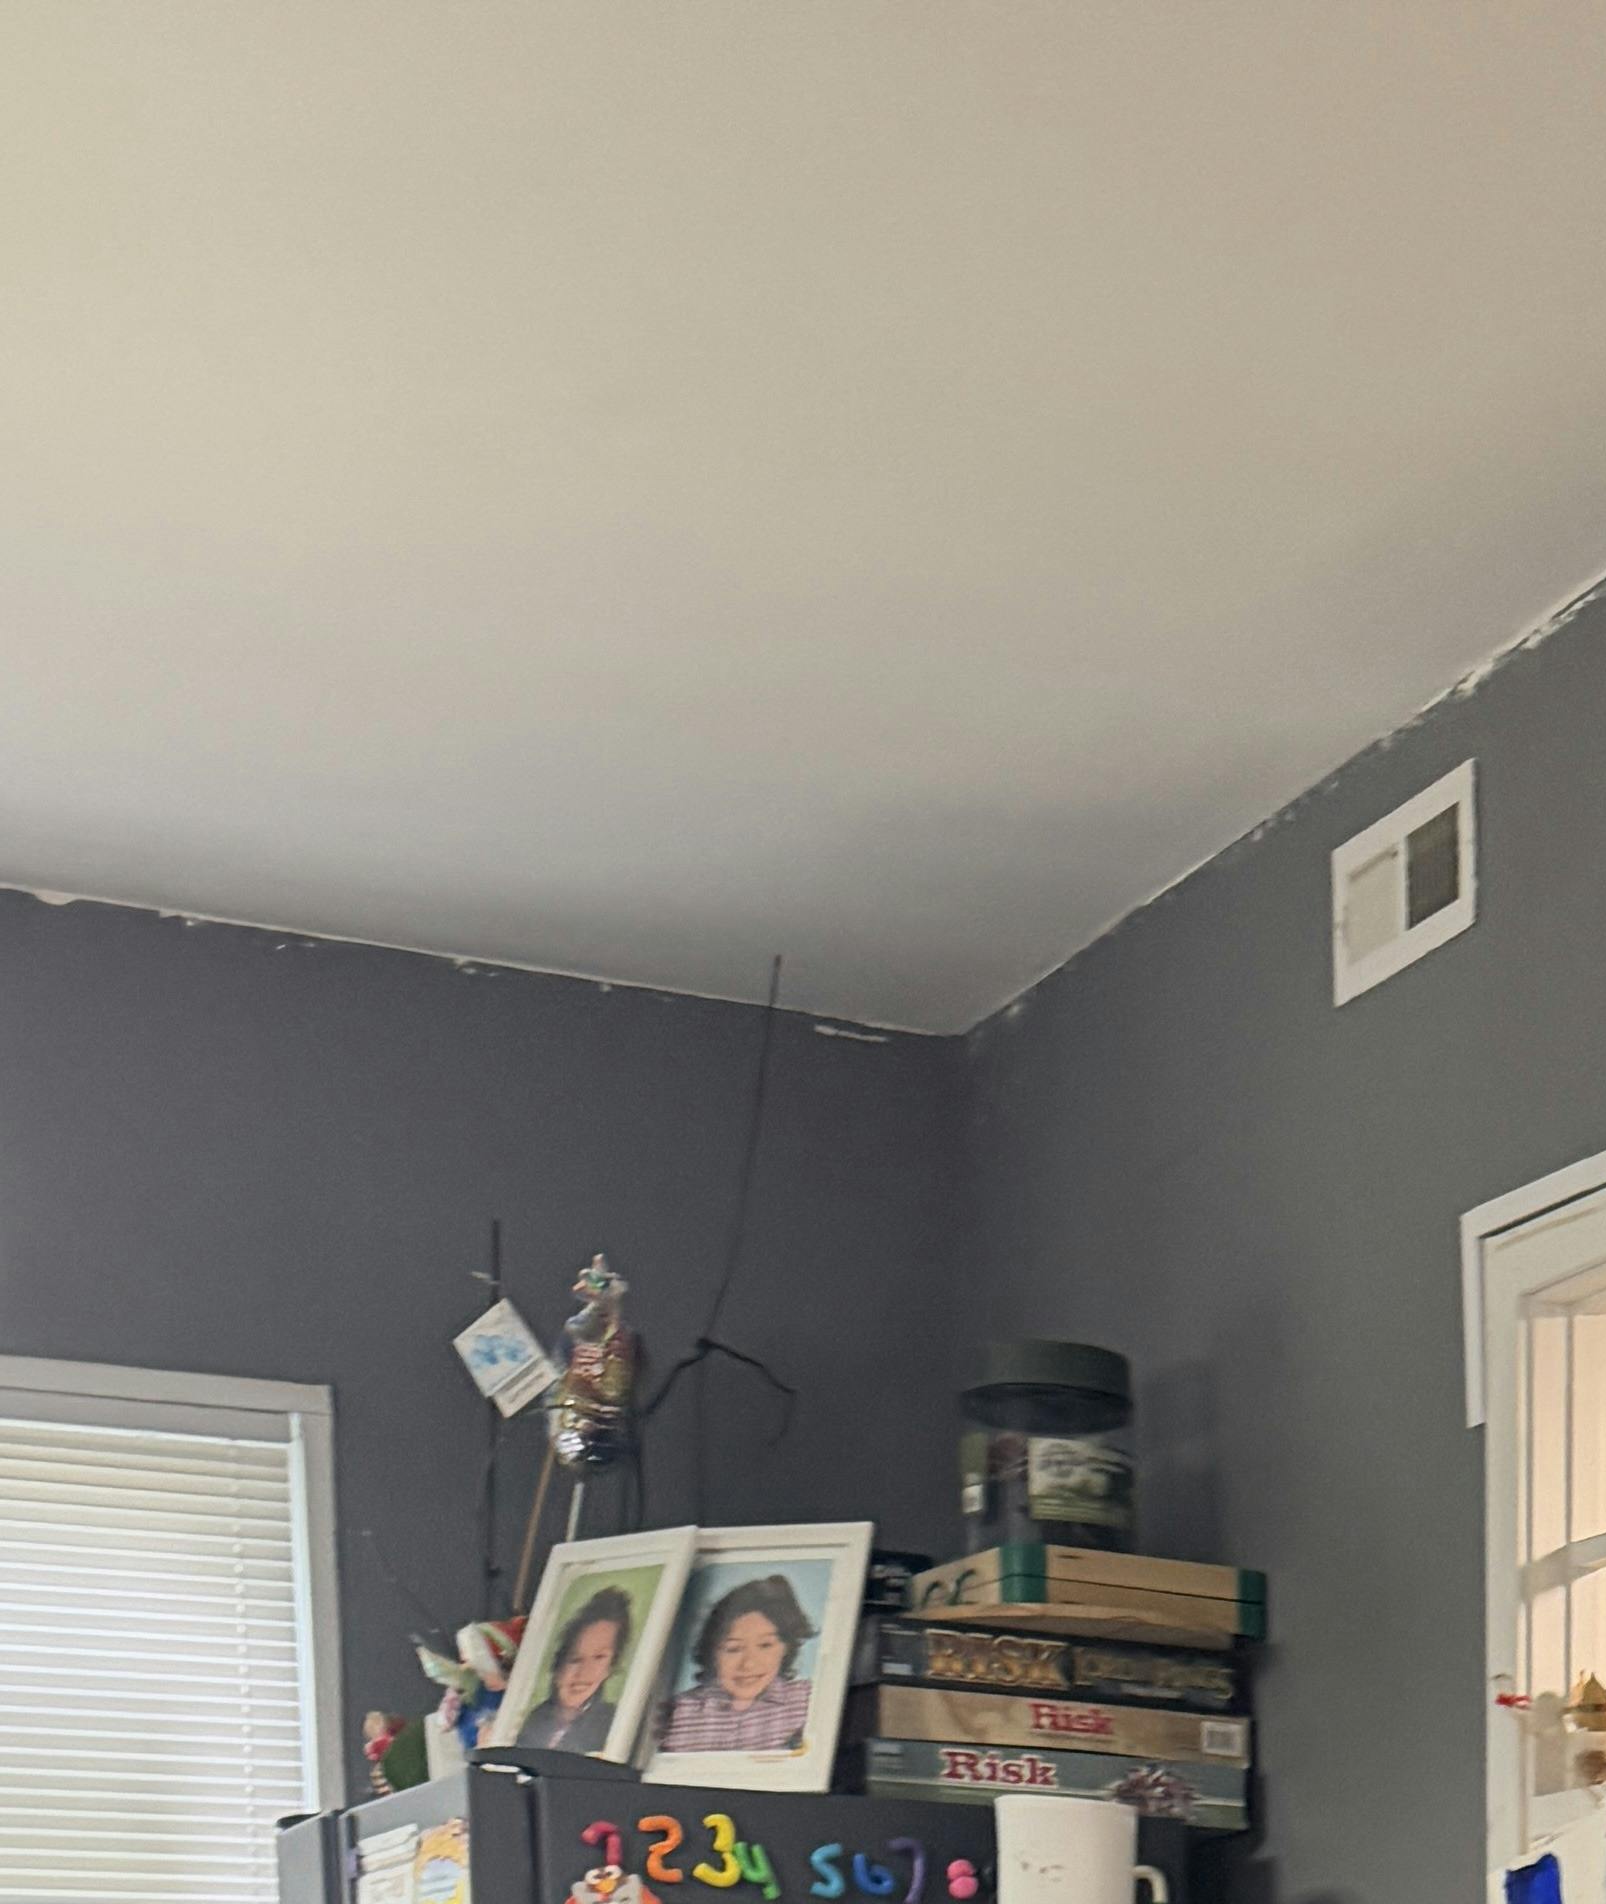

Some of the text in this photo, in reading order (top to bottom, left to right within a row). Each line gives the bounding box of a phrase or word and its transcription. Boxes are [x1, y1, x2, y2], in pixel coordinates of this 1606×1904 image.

[925, 1629, 1071, 1690] RISK
[941, 1750, 1057, 1787] Risk
[637, 1815, 683, 1883] 2
[693, 1813, 741, 1888] 3
[734, 1841, 781, 1900] 4
[810, 1843, 844, 1898] 5
[853, 1852, 893, 1895] 6
